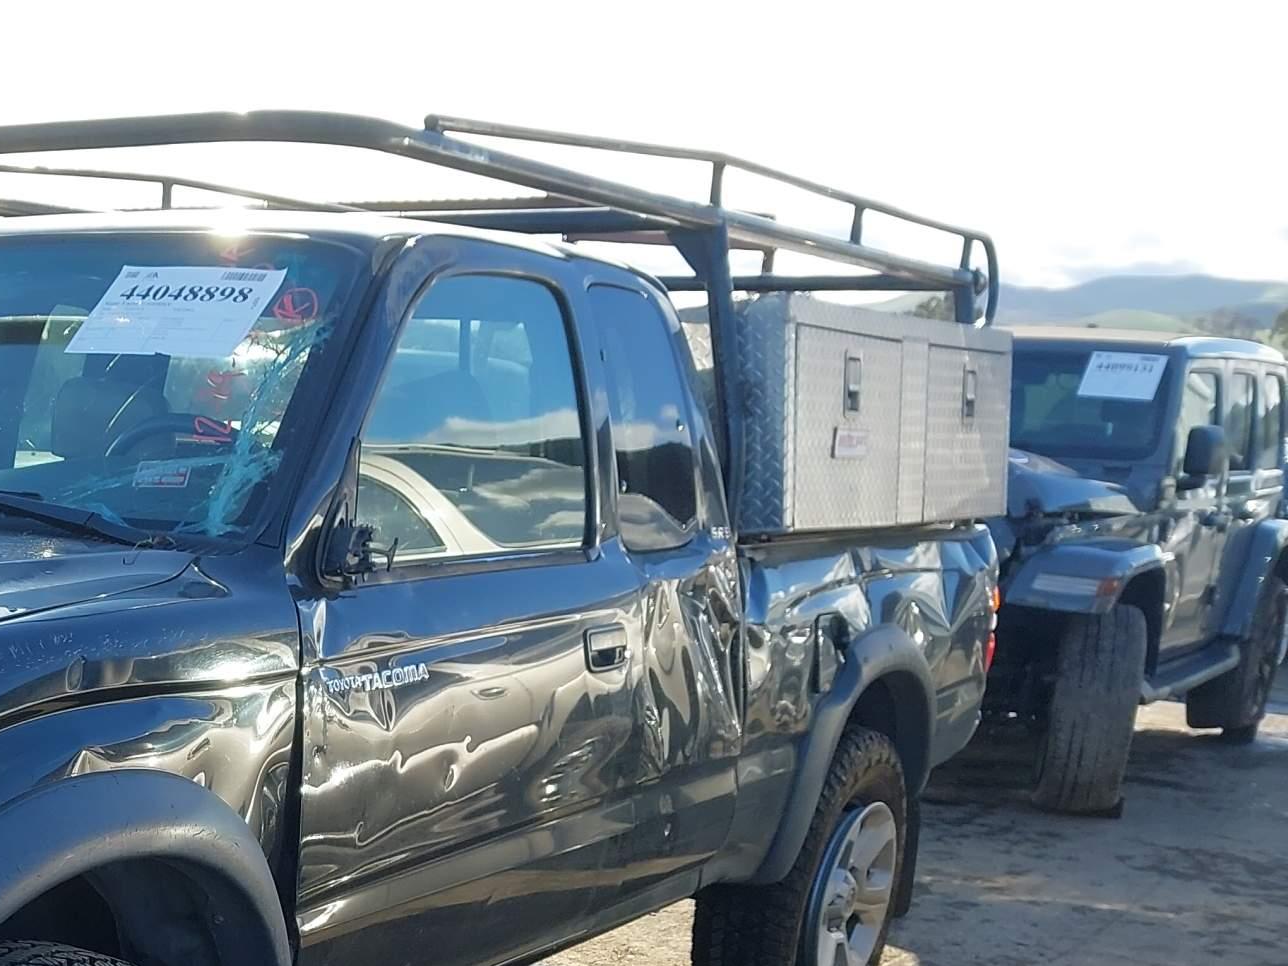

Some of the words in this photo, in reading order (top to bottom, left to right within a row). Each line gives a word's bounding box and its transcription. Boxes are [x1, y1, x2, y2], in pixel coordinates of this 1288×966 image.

[120, 284, 253, 303] 44048898
[326, 674, 362, 693] TOYOTA
[361, 663, 430, 691] TACOMA
